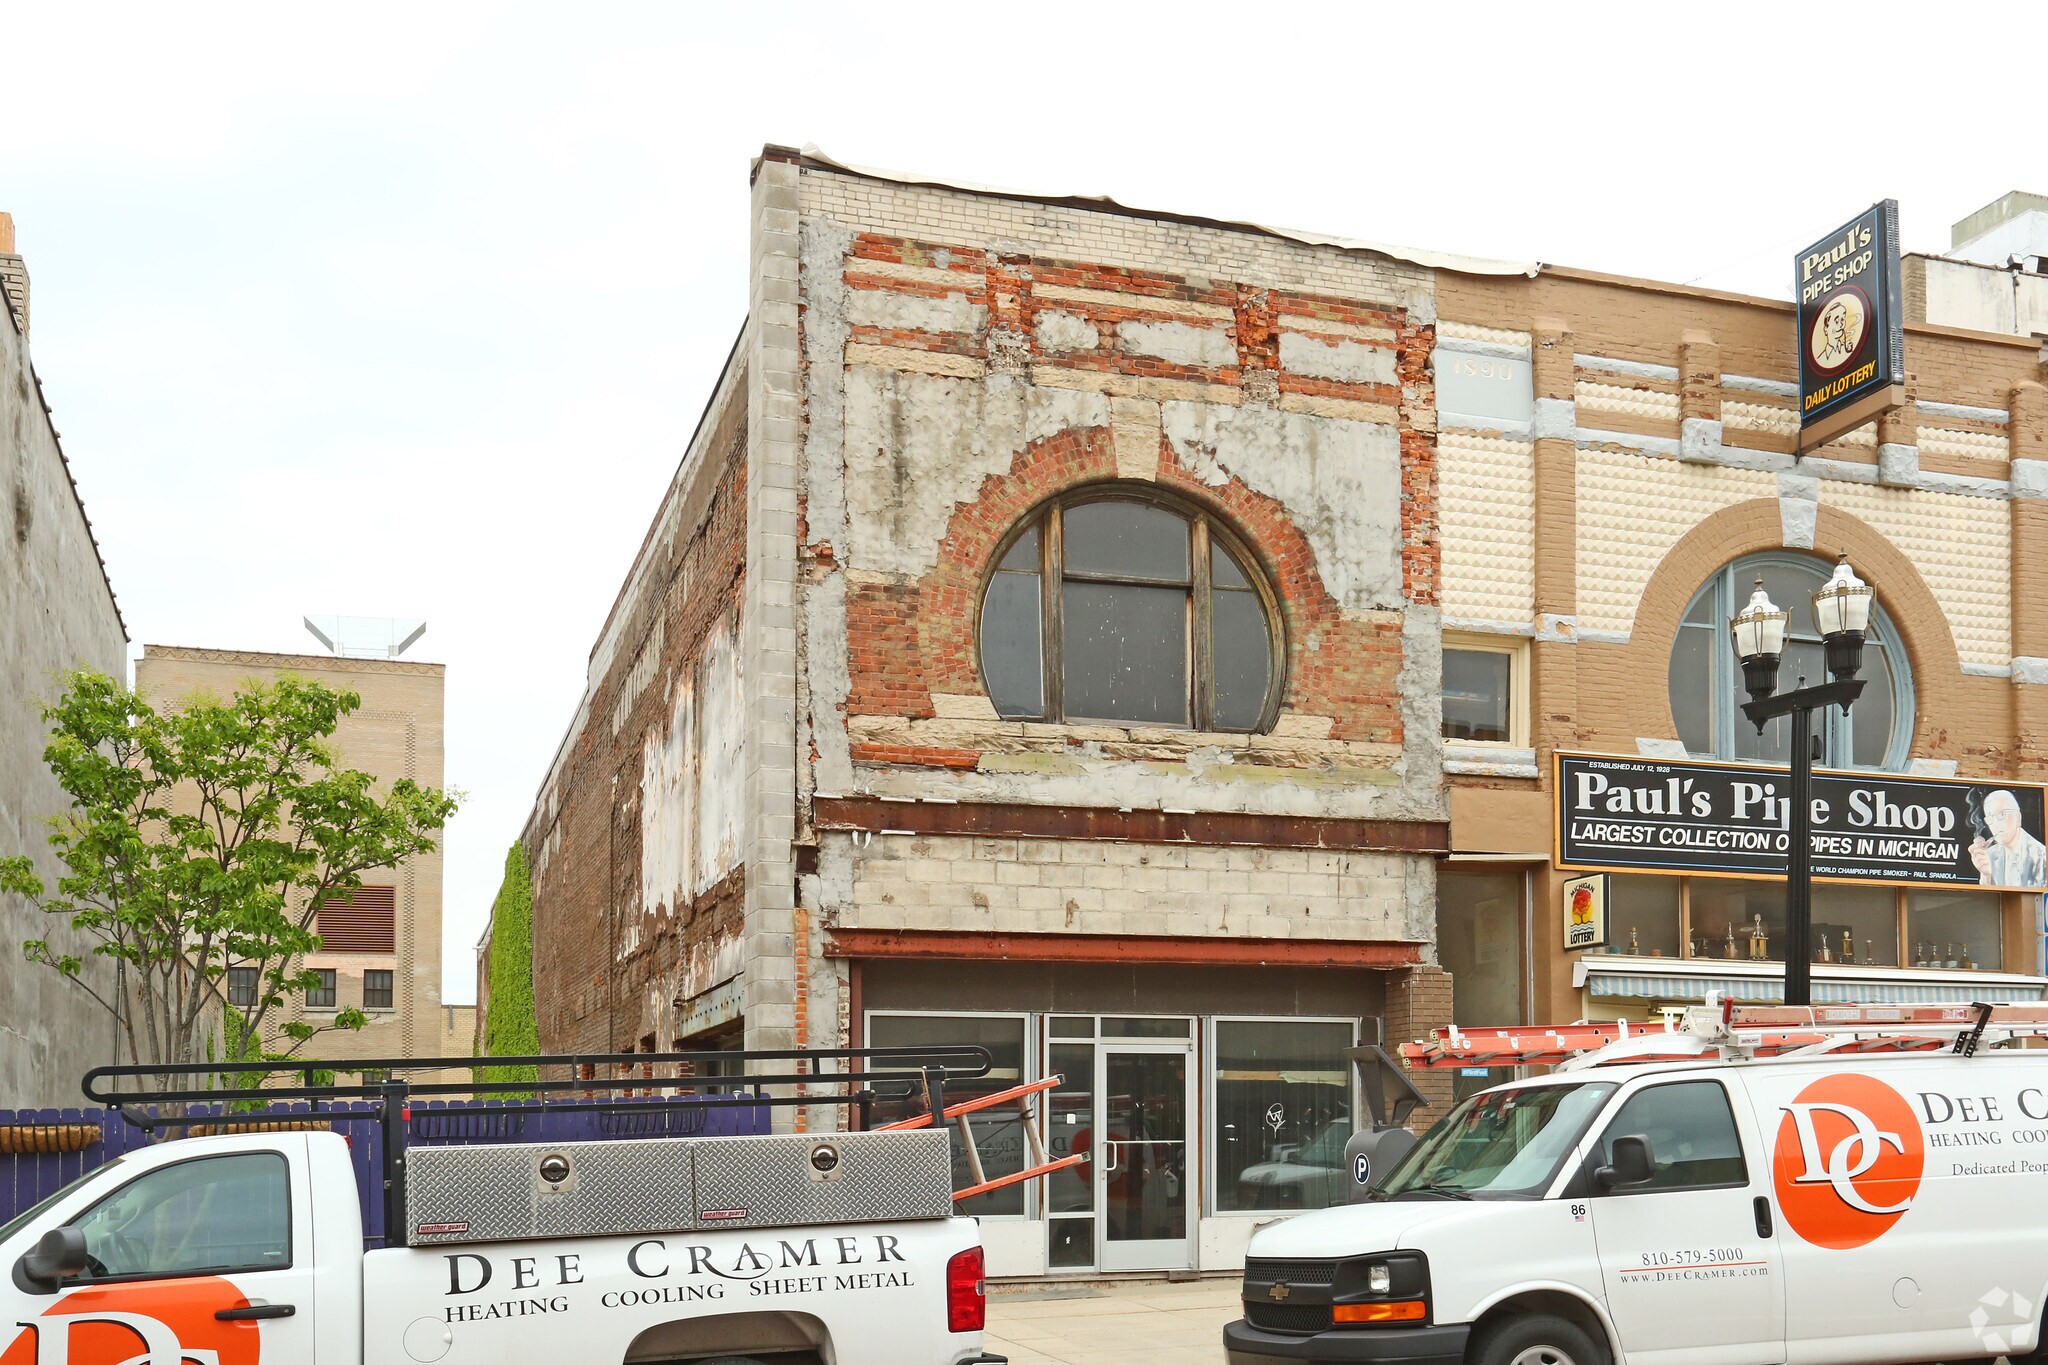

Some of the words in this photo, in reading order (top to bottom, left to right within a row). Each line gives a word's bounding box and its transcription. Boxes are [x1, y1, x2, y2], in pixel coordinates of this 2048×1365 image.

[1802, 223, 1872, 283] Paul's
[1803, 273, 1833, 305] PIPE
[1834, 250, 1873, 286] SHOP
[1805, 383, 1832, 411] DAILY
[1832, 360, 1876, 396] LOTTERY
[1589, 761, 1630, 771] ESTABLISHED
[1631, 764, 1646, 772] JULY
[1647, 765, 1655, 773] 12,
[1574, 771, 1712, 818] Paul's
[1848, 789, 1955, 839] Shop
[1570, 822, 1656, 843] LARGEST
[1658, 827, 1771, 849] COLLECTION
[1775, 833, 1790, 851] O
[1858, 838, 1874, 855] IN
[1877, 839, 1959, 858] MICHIGAN
[1837, 867, 1869, 875] CHAMPION
[1570, 882, 1595, 897] MICHIGAN
[1570, 931, 1595, 945] LOTTERY
[1930, 1131, 2002, 1147] HEATING
[2012, 1129, 2048, 1144] COO
[1779, 1102, 1912, 1215] DC
[1952, 1160, 2016, 1176] Dedicated
[1571, 1204, 1586, 1215] 86
[1641, 1248, 1743, 1266] 810-579-5000
[445, 1296, 569, 1323] HEATING
[601, 1283, 725, 1308] COOLING
[749, 1275, 827, 1297] SHEET
[834, 1272, 915, 1291] METAL
